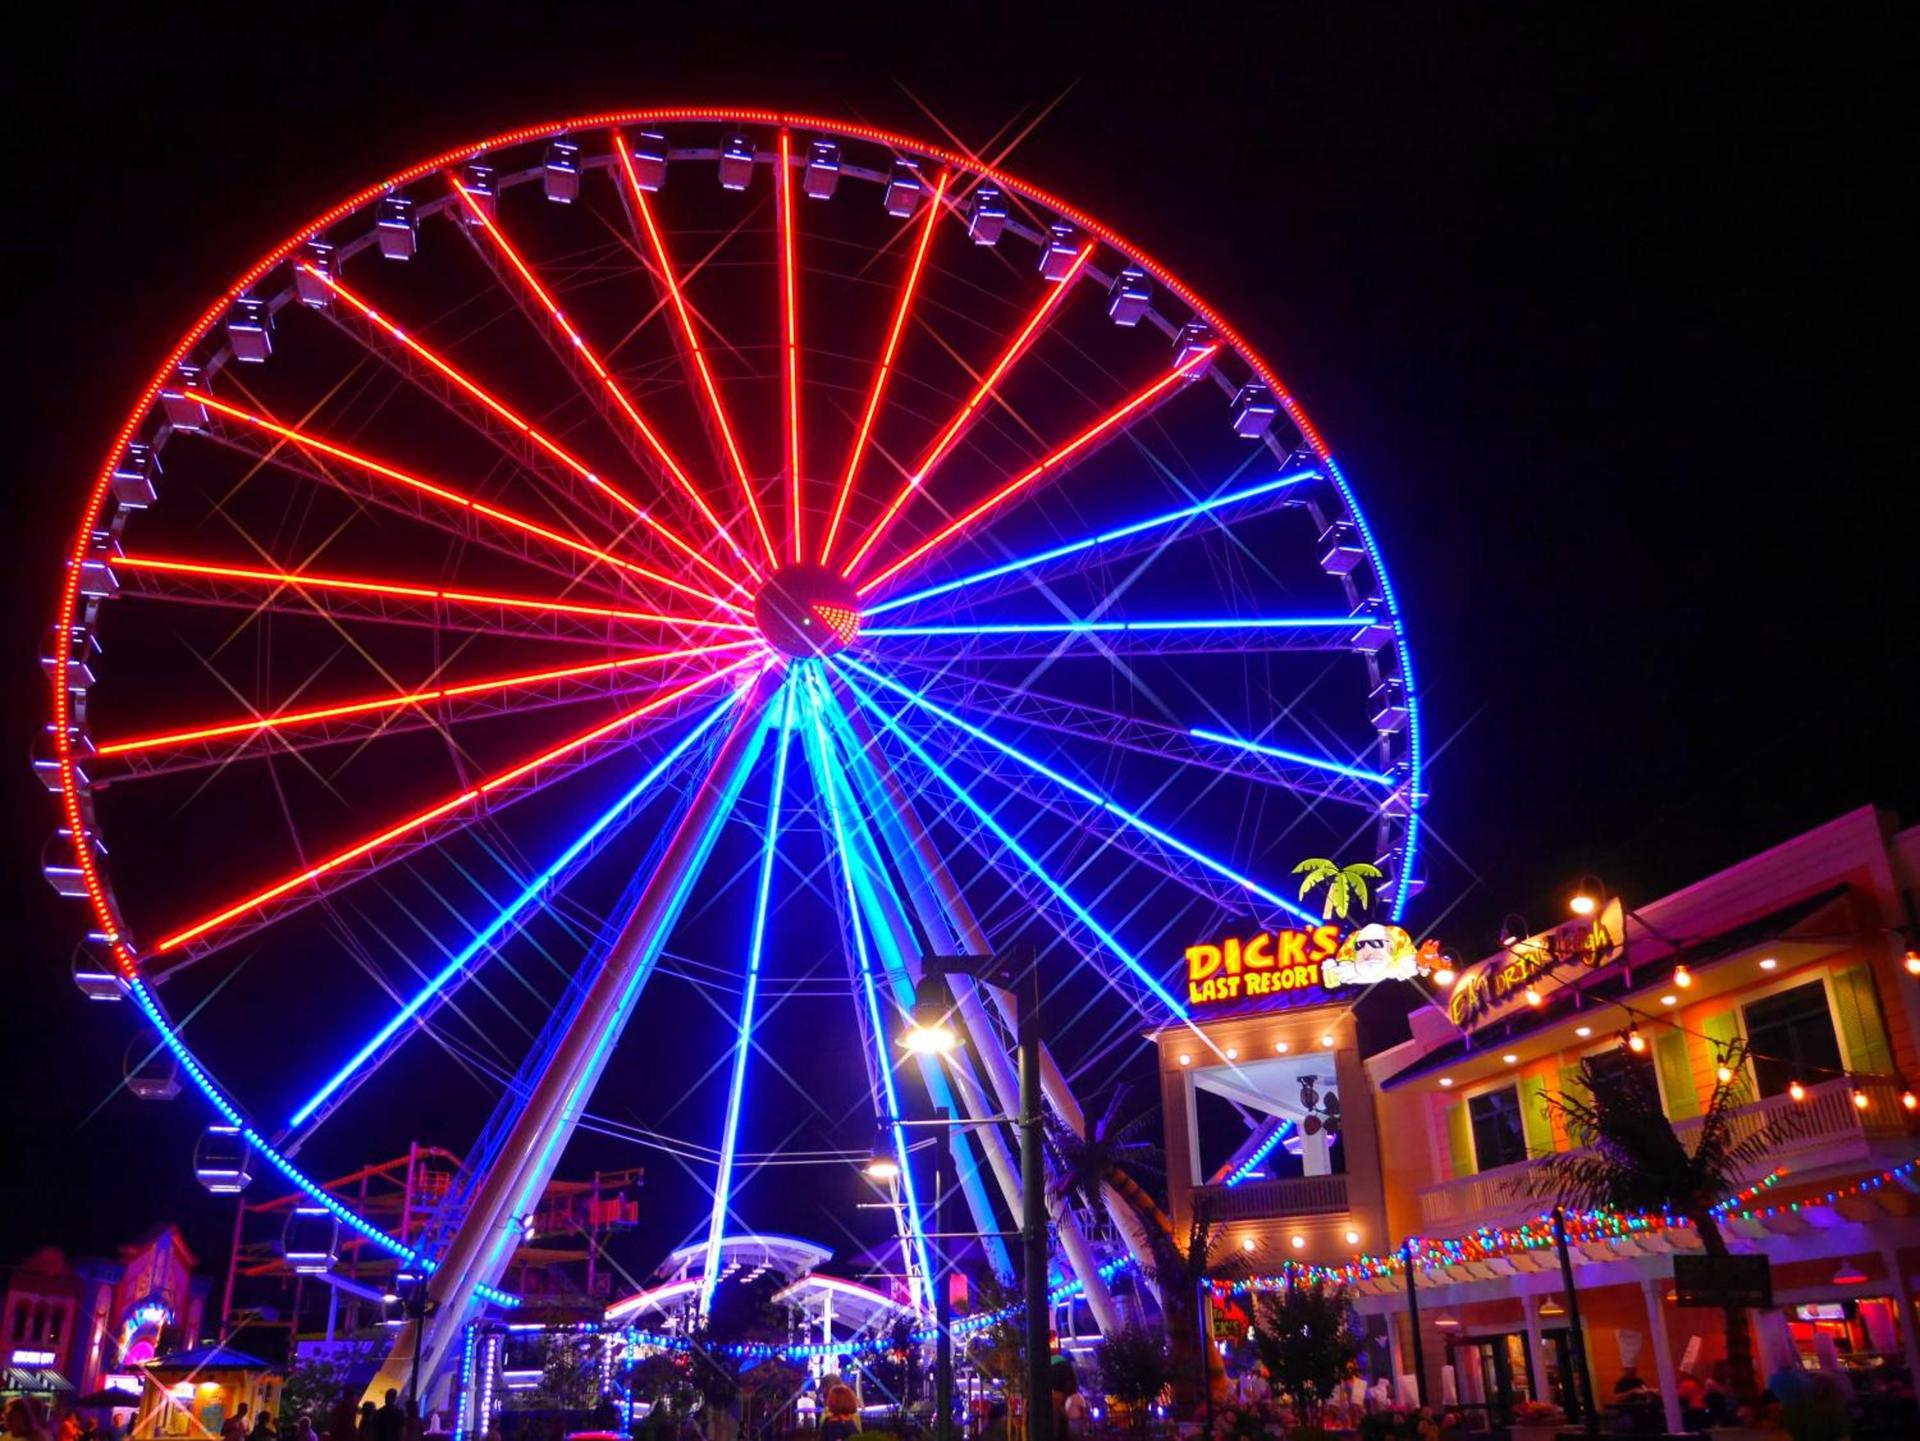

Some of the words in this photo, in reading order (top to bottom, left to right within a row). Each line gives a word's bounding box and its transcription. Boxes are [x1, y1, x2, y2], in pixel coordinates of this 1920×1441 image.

[1185, 924, 1339, 980] DICK'S
[1189, 975, 1241, 1004] LAST
[1244, 964, 1319, 996] RESORT
